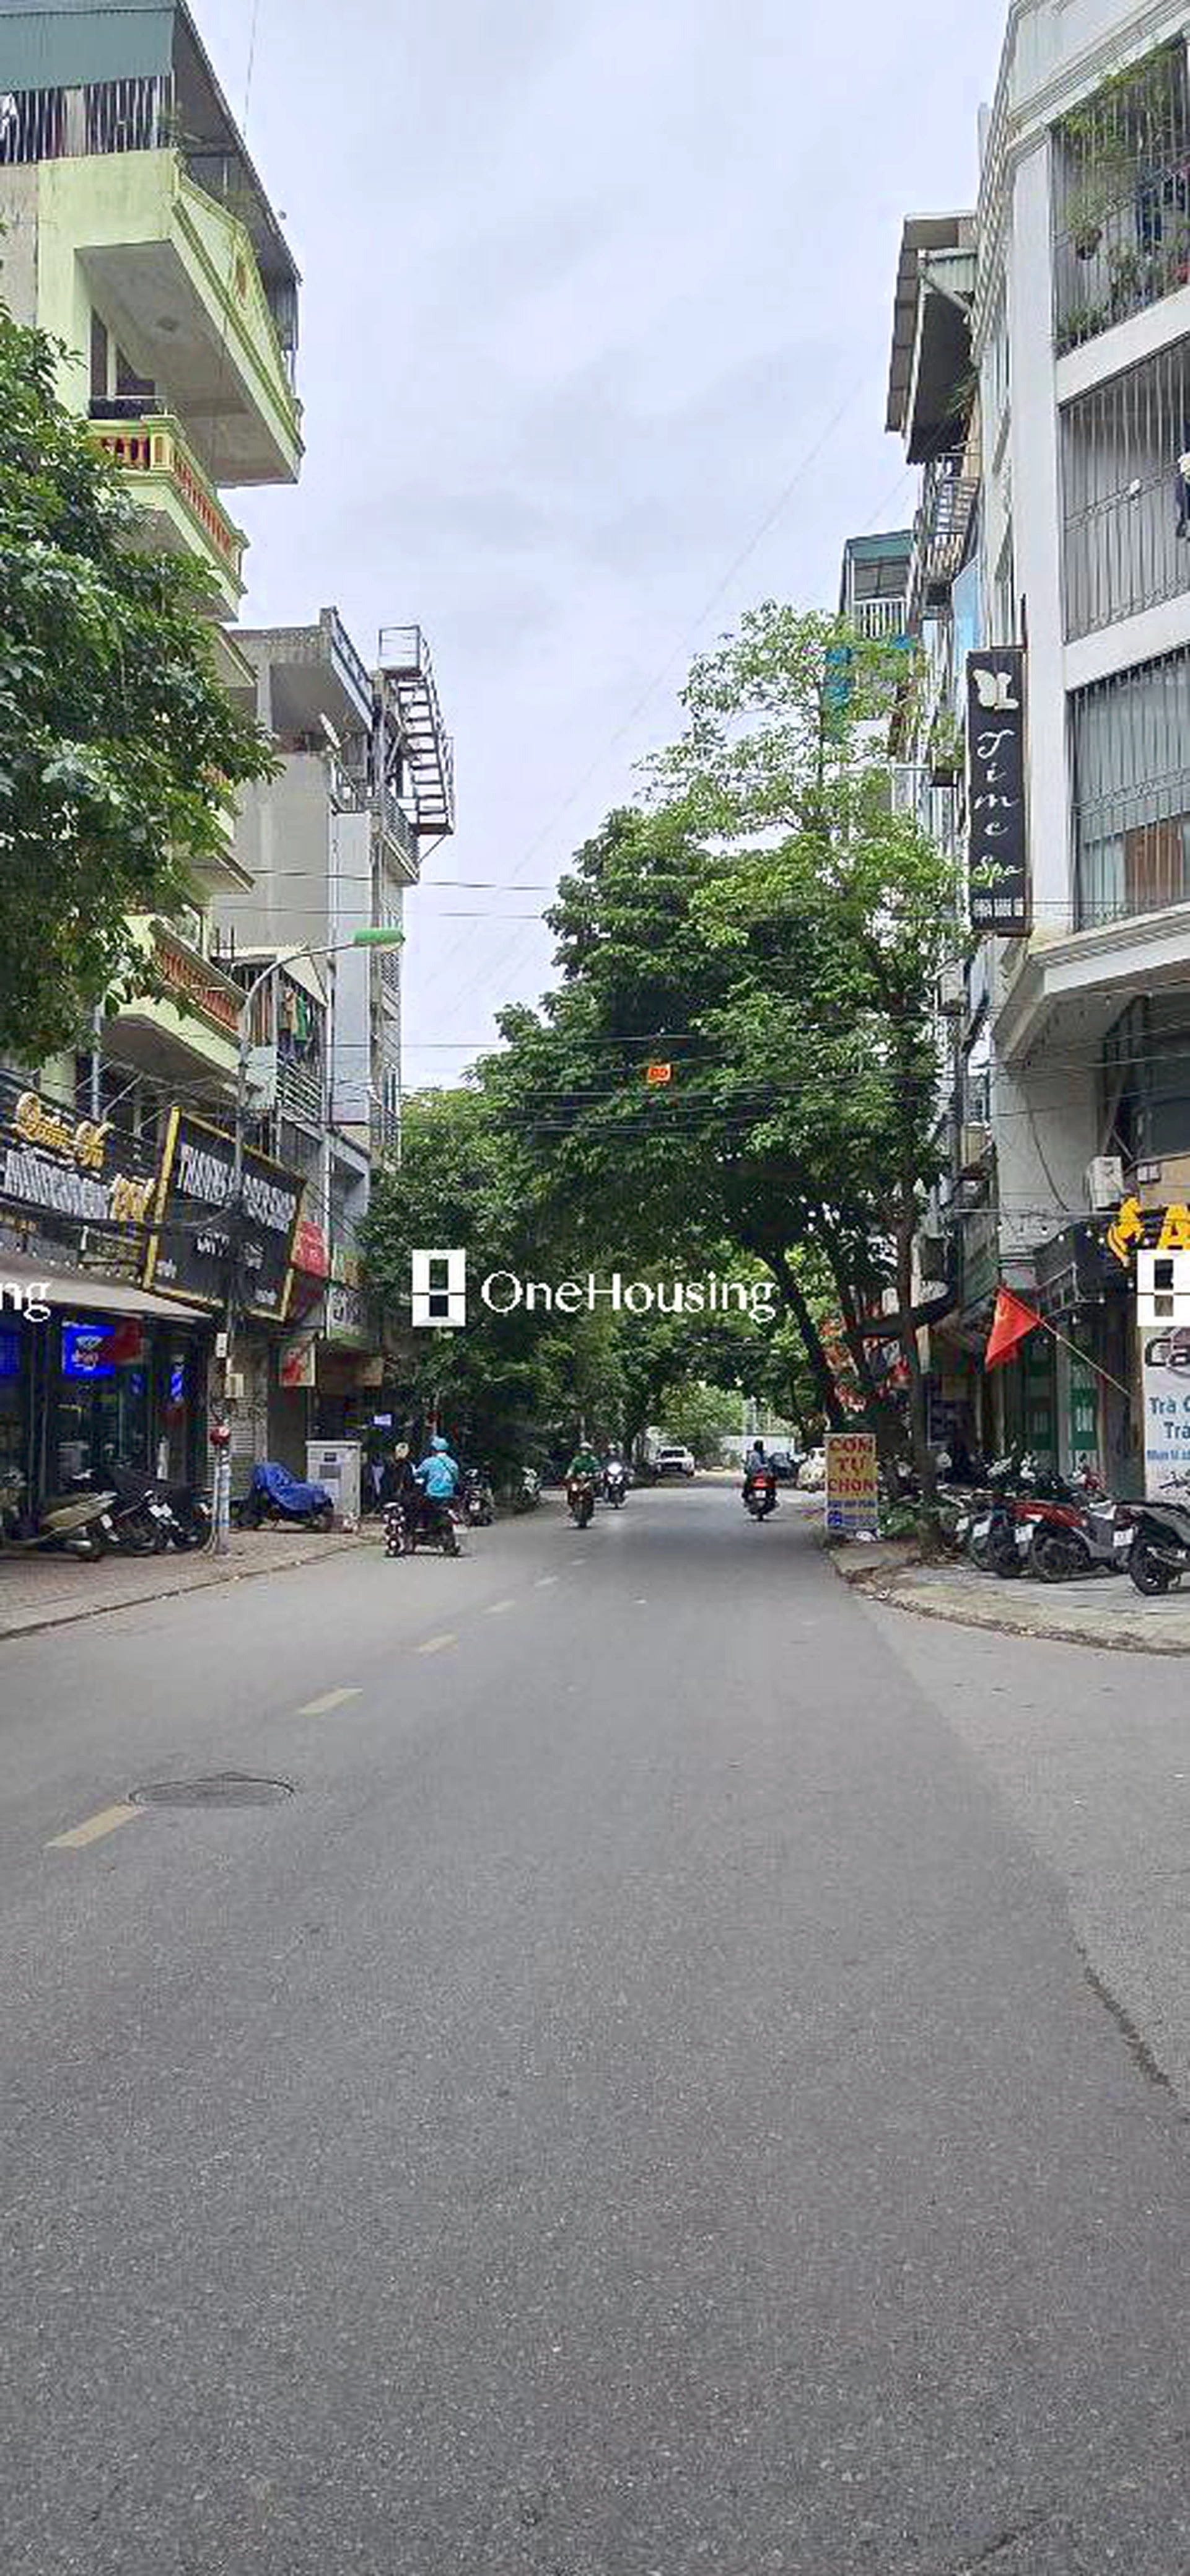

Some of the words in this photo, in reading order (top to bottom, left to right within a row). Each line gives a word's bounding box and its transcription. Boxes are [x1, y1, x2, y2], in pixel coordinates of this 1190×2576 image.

[974, 730, 1020, 836] Time
[973, 856, 1023, 887] Spa
[1148, 1395, 1176, 1414] Trà
